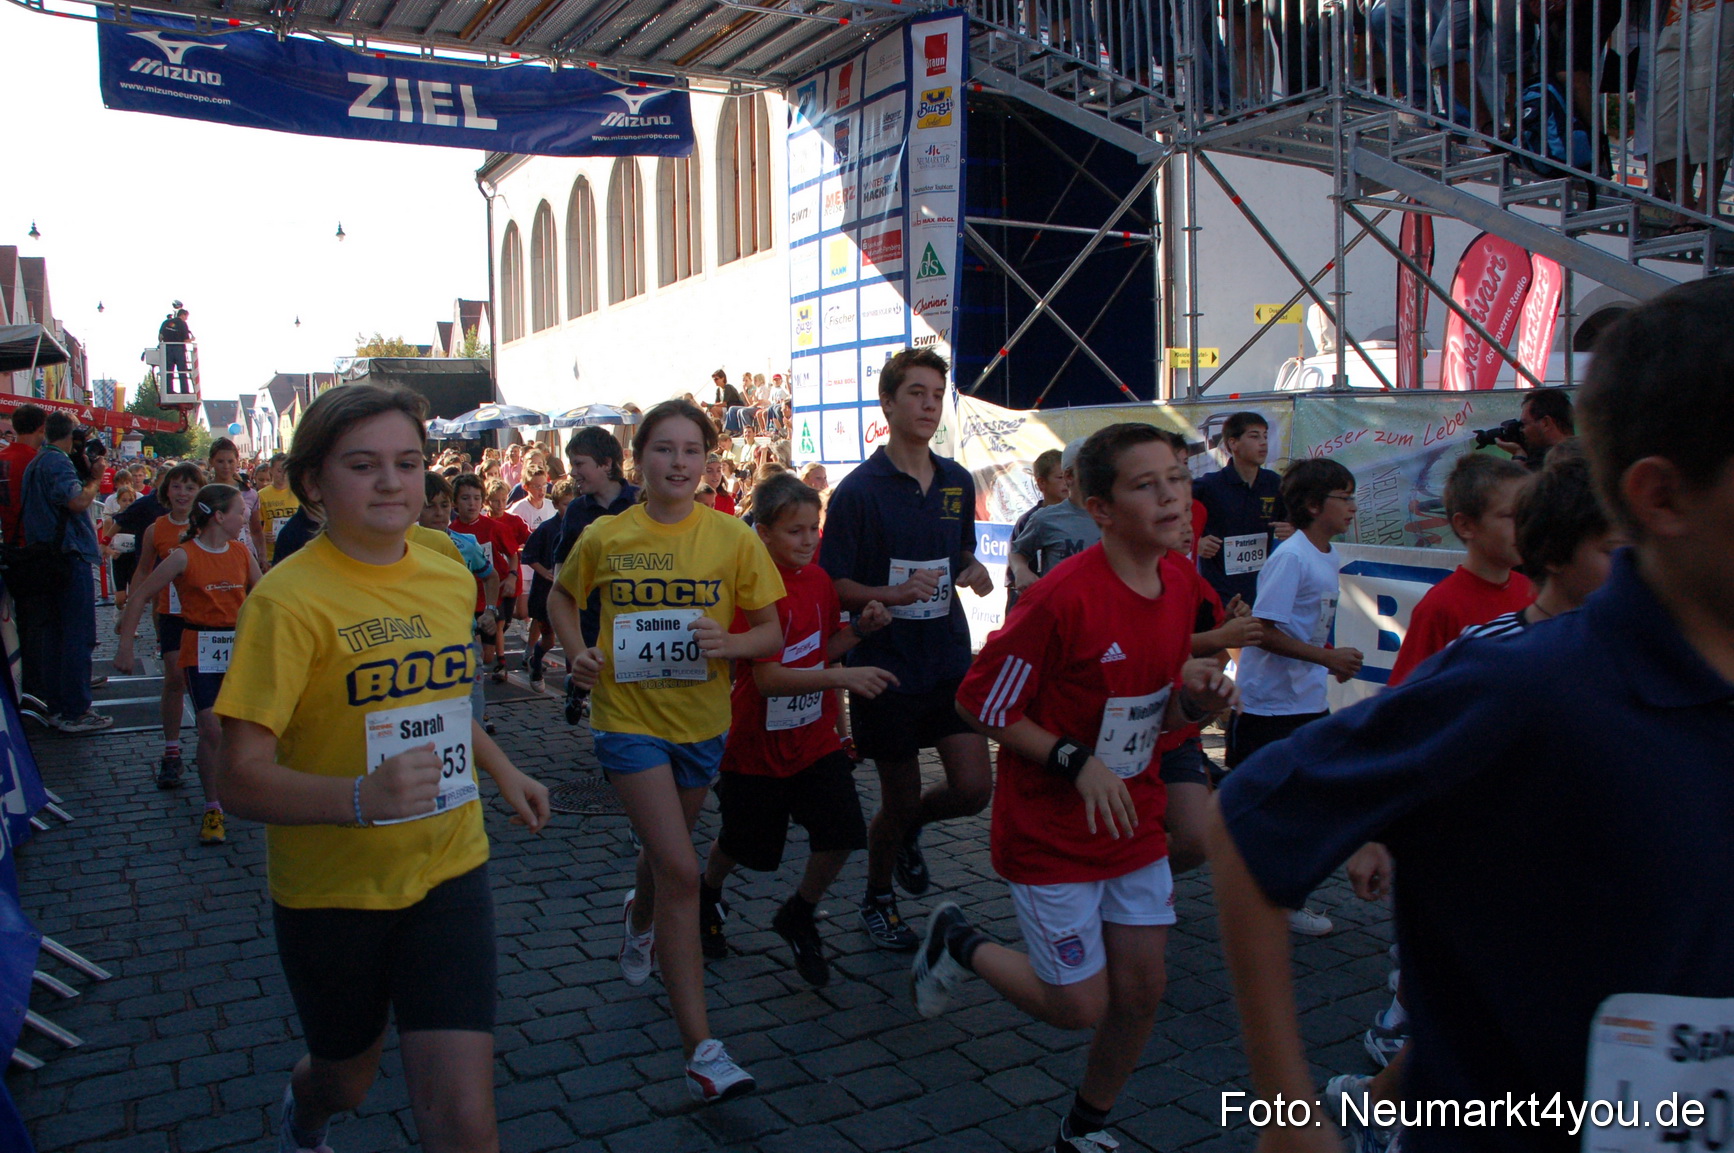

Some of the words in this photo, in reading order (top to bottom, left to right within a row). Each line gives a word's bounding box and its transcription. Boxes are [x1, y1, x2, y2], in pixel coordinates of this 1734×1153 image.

[119, 81, 232, 106] www.mizunoeurope.com
[346, 72, 498, 130] ZIEL
[591, 132, 680, 141] www.mizunoeurope.com
[1509, 276, 1527, 307] Radio
[913, 334, 937, 346] swn
[1373, 430, 1414, 447] zum
[1423, 401, 1473, 446] Leben
[1372, 465, 1405, 547] NEUMAR
[1235, 538, 1257, 548] Patrick
[607, 552, 674, 572] TEAM
[1236, 548, 1264, 563] 4089
[609, 577, 723, 608] BOCK
[338, 614, 432, 653] TEAM
[636, 618, 681, 632] Sabine
[618, 638, 626, 651] J
[638, 640, 700, 662] 4150
[400, 713, 445, 740] Sarah
[1104, 728, 1116, 742] J
